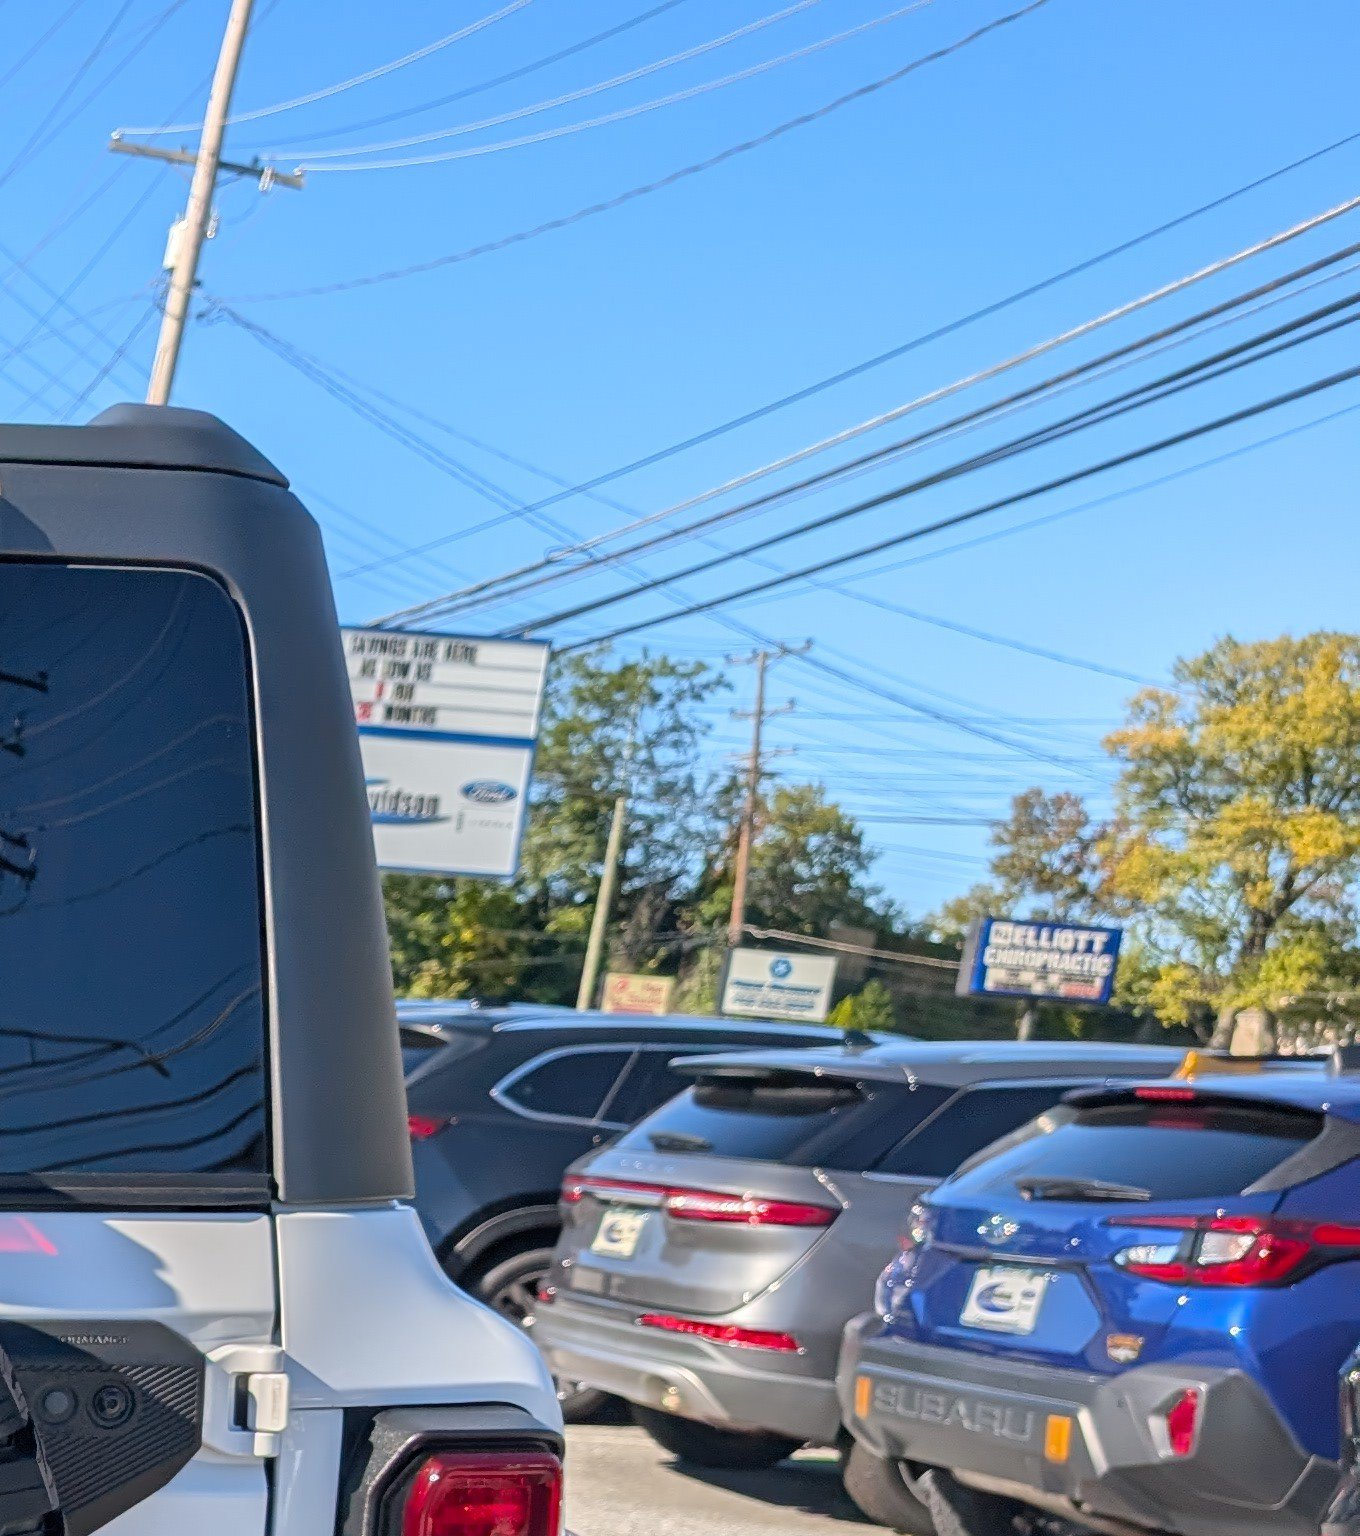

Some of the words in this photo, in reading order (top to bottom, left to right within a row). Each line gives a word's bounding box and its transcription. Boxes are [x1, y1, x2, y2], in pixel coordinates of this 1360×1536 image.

[369, 789, 438, 817] vidson
[1013, 923, 1110, 953] ELLIOTT
[874, 1384, 1034, 1442] SUBARU
